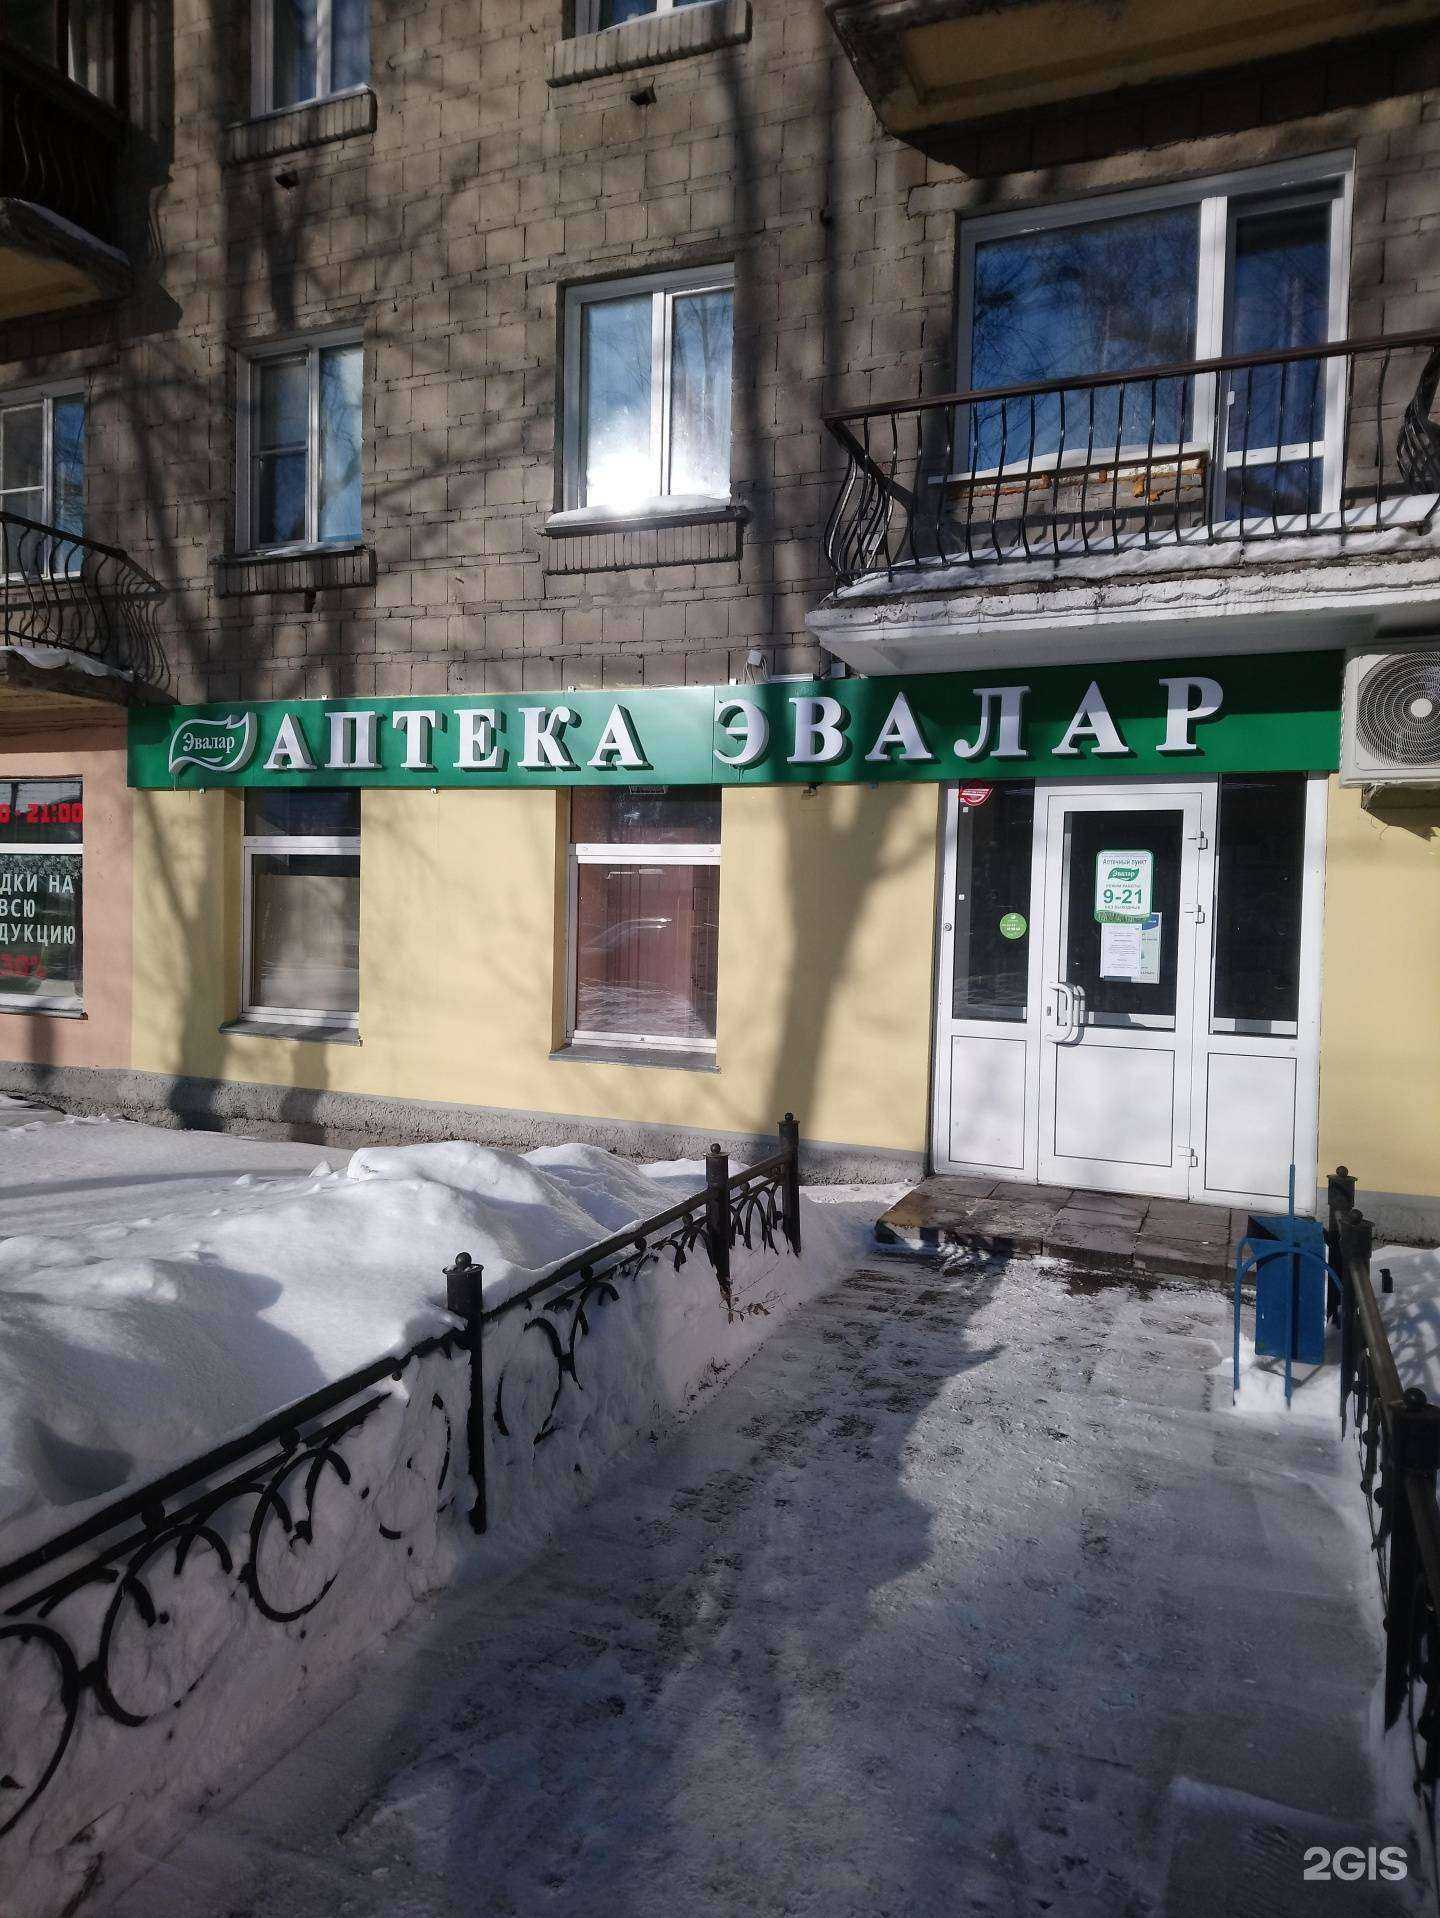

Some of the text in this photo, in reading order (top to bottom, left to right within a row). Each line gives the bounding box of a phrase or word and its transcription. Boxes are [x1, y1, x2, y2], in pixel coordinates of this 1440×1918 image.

[262, 676, 1225, 770] АПТЕКА ЭВАЛАР
[182, 732, 235, 754] Эвалар
[27, 803, 83, 824] 21:00
[0, 873, 75, 896] ДКИ НА
[1103, 889, 1142, 904] 9-21
[0, 899, 36, 918] ВСЮ
[0, 923, 76, 947] ДУКЦИЮ
